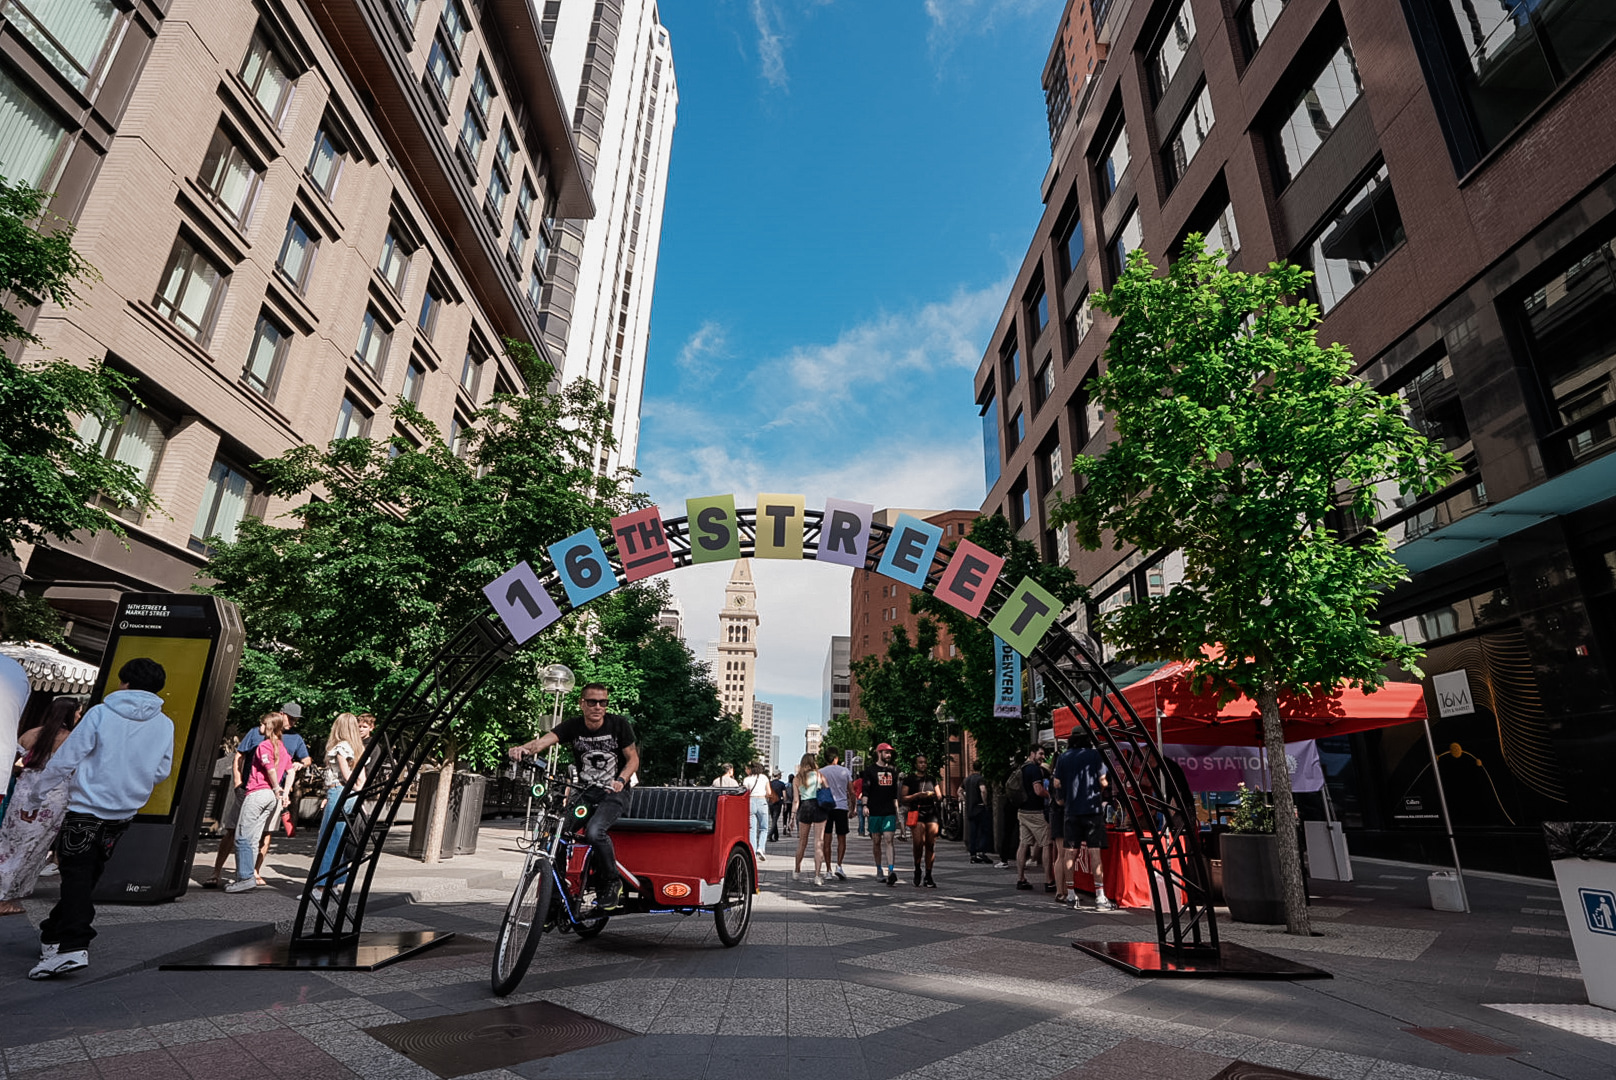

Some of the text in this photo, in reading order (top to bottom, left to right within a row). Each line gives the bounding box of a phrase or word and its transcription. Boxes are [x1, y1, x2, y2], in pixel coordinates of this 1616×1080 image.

[506, 505, 1050, 636] 16TH STREET
[1002, 645, 1013, 694] DENVER
[126, 883, 140, 892] ike
